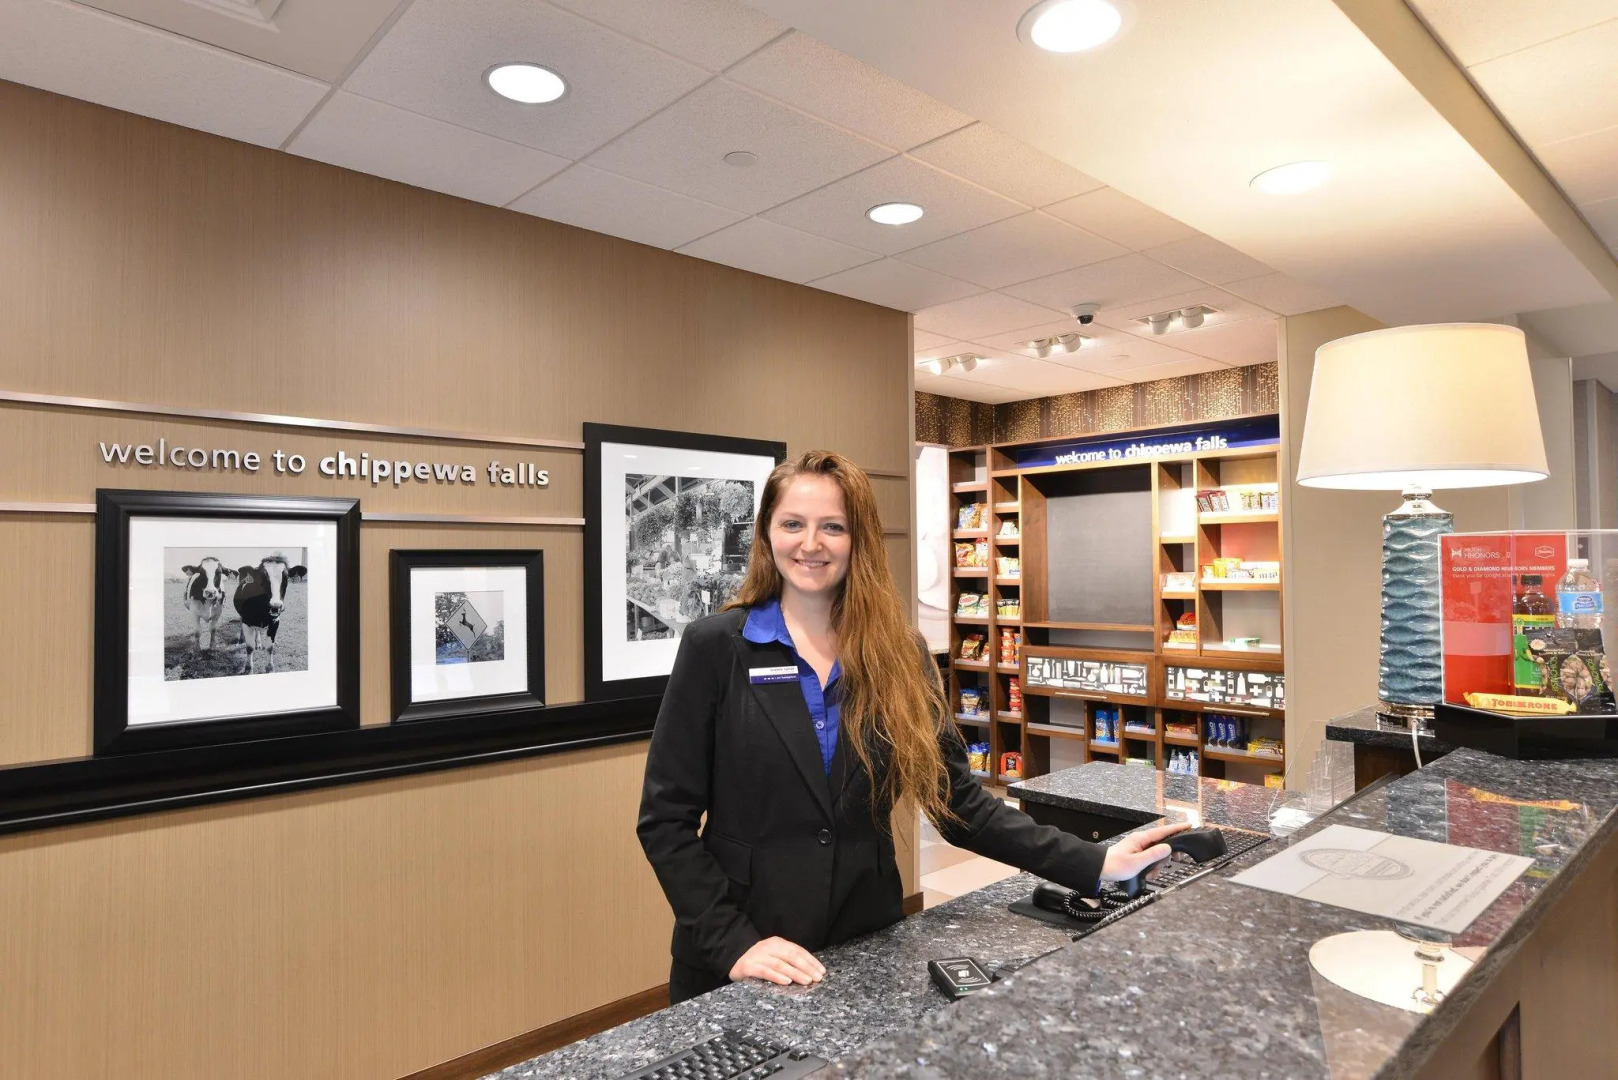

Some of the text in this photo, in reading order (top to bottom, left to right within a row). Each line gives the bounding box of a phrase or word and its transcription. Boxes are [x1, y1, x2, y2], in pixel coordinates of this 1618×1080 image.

[99, 437, 549, 486] welcome to chippewa falls
[1055, 435, 1228, 465] welcome to chippewa falls
[1464, 551, 1501, 559] HHONORS
